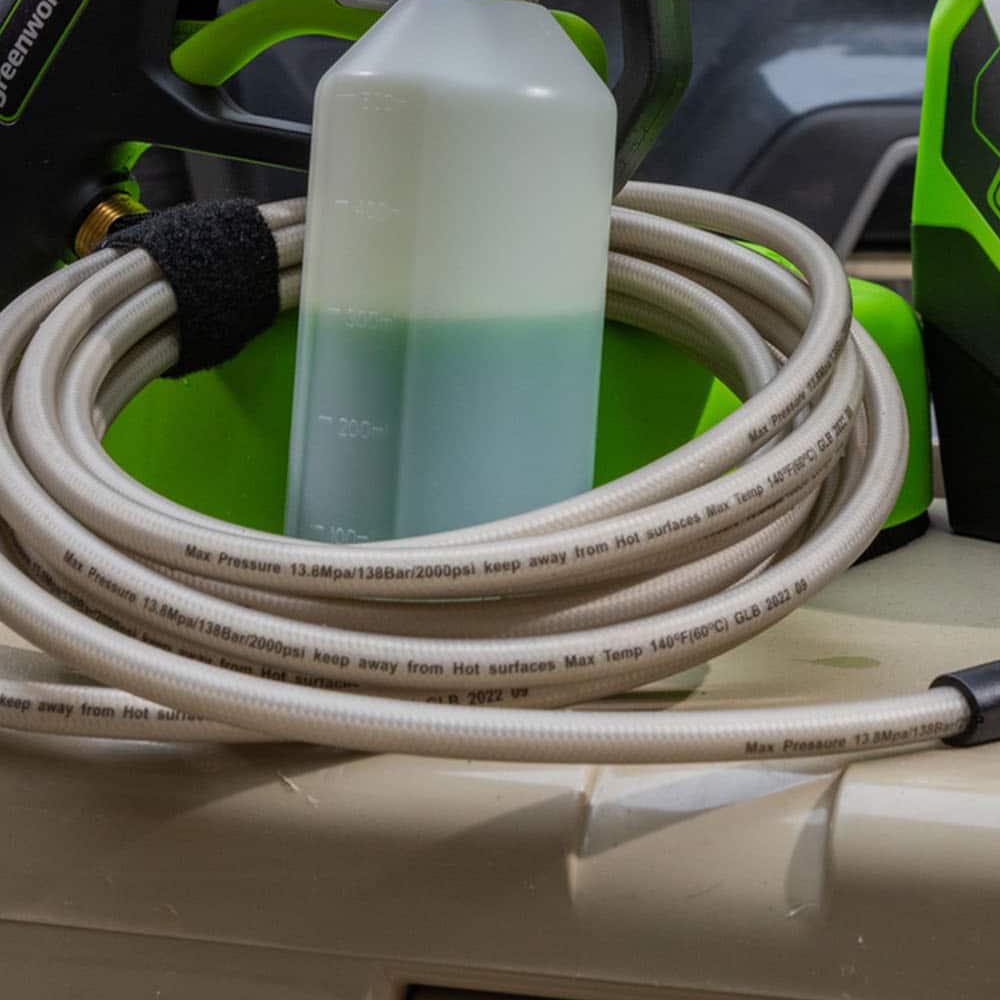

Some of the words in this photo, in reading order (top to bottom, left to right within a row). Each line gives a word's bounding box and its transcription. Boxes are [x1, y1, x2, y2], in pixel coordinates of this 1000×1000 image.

[185, 544, 211, 562] Max
[218, 552, 281, 574] Pressure
[484, 561, 521, 575] keep
[529, 551, 568, 568] away
[575, 541, 609, 558] from
[615, 532, 640, 549] Hot
[647, 513, 702, 540] surfaces
[706, 499, 731, 518] Max
[734, 483, 765, 504] Temp
[63, 549, 84, 573] Max
[88, 566, 137, 602] Pressure
[314, 648, 350, 668] keep
[358, 657, 398, 675] away
[407, 660, 444, 675] from
[453, 662, 480, 675] Hot
[489, 659, 556, 675] surfaces
[564, 653, 595, 669] Max
[603, 646, 642, 663] Temp
[734, 604, 762, 625] GLB
[766, 588, 792, 611] 2022
[38, 701, 74, 717] away
[81, 703, 115, 718] from
[123, 706, 149, 720] Hot
[744, 741, 774, 753] Max
[783, 737, 847, 752] Pressure
